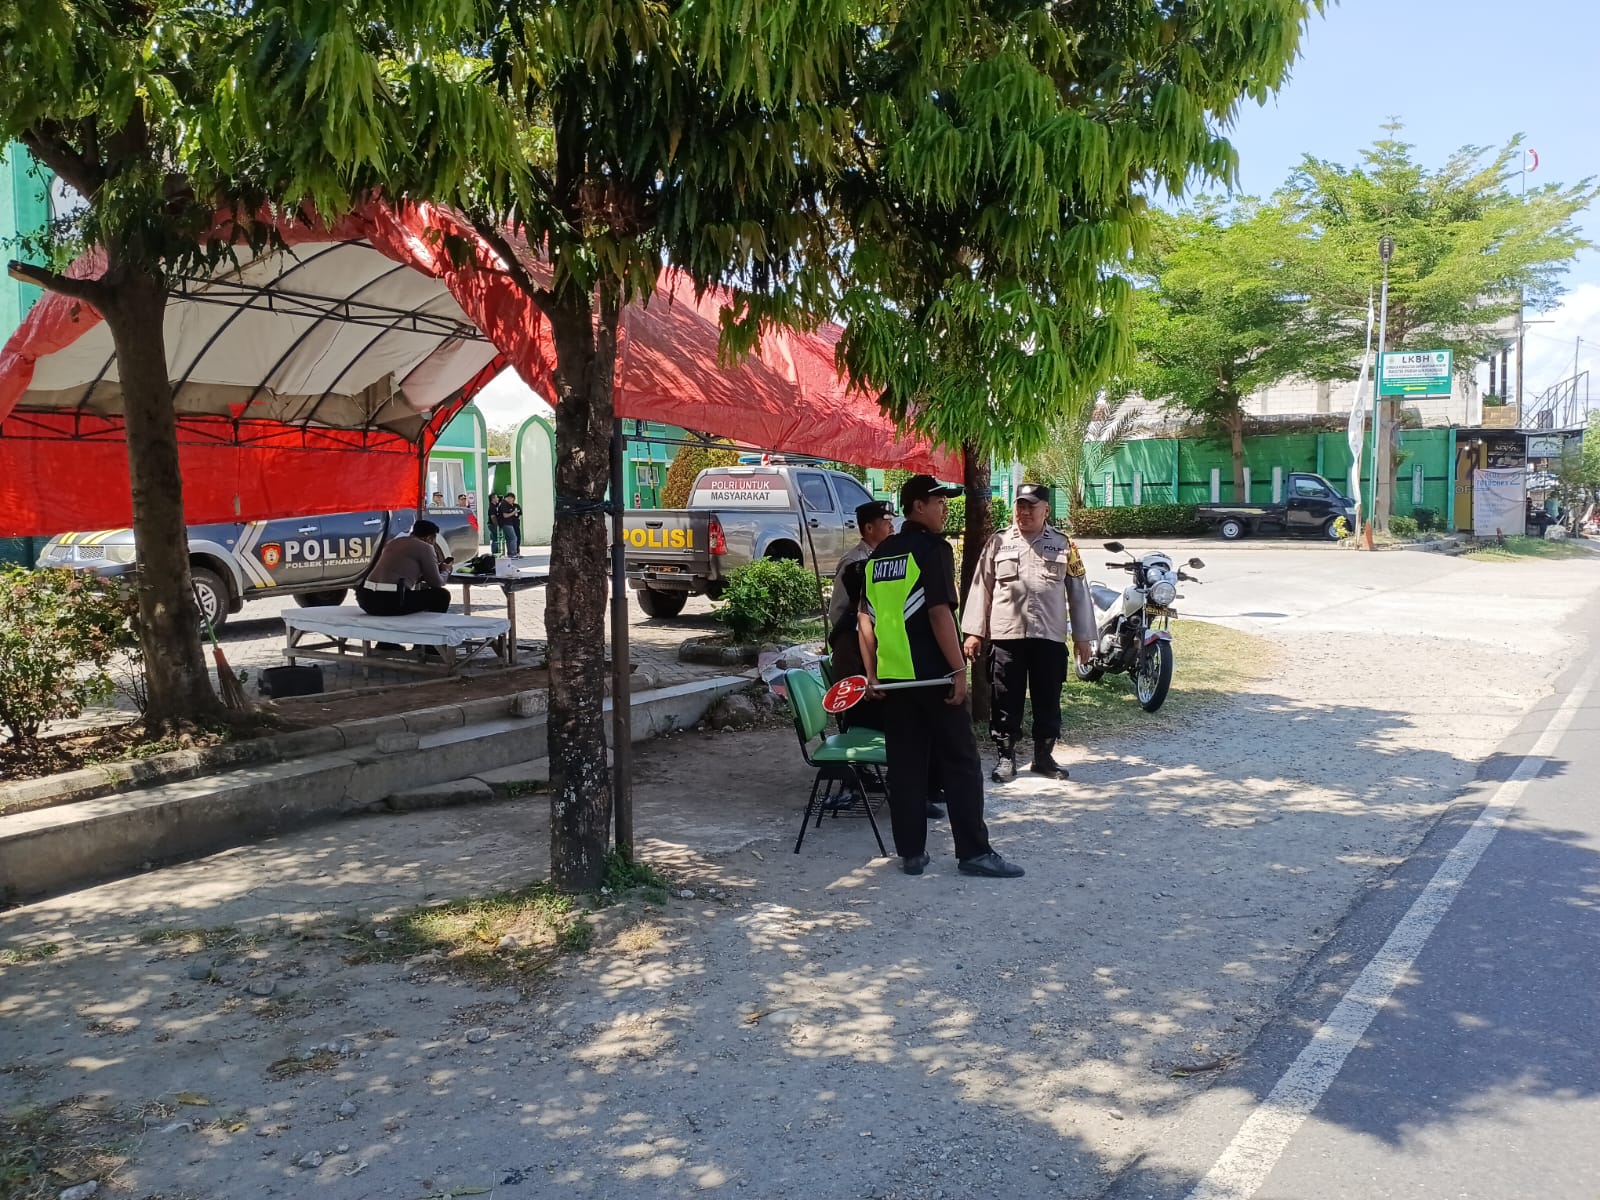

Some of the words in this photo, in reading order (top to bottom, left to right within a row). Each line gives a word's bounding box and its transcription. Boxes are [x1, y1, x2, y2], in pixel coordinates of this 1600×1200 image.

[1402, 355, 1430, 364] LKBH
[711, 481, 738, 490] POLRI
[739, 481, 770, 490] UNTUK
[710, 491, 770, 501] MASYARAKAT
[284, 536, 372, 562] POLISI
[285, 560, 322, 569] POLSEK
[324, 557, 371, 567] JENANGAN
[873, 559, 907, 580] SATPAM
[832, 680, 853, 710] STOP
